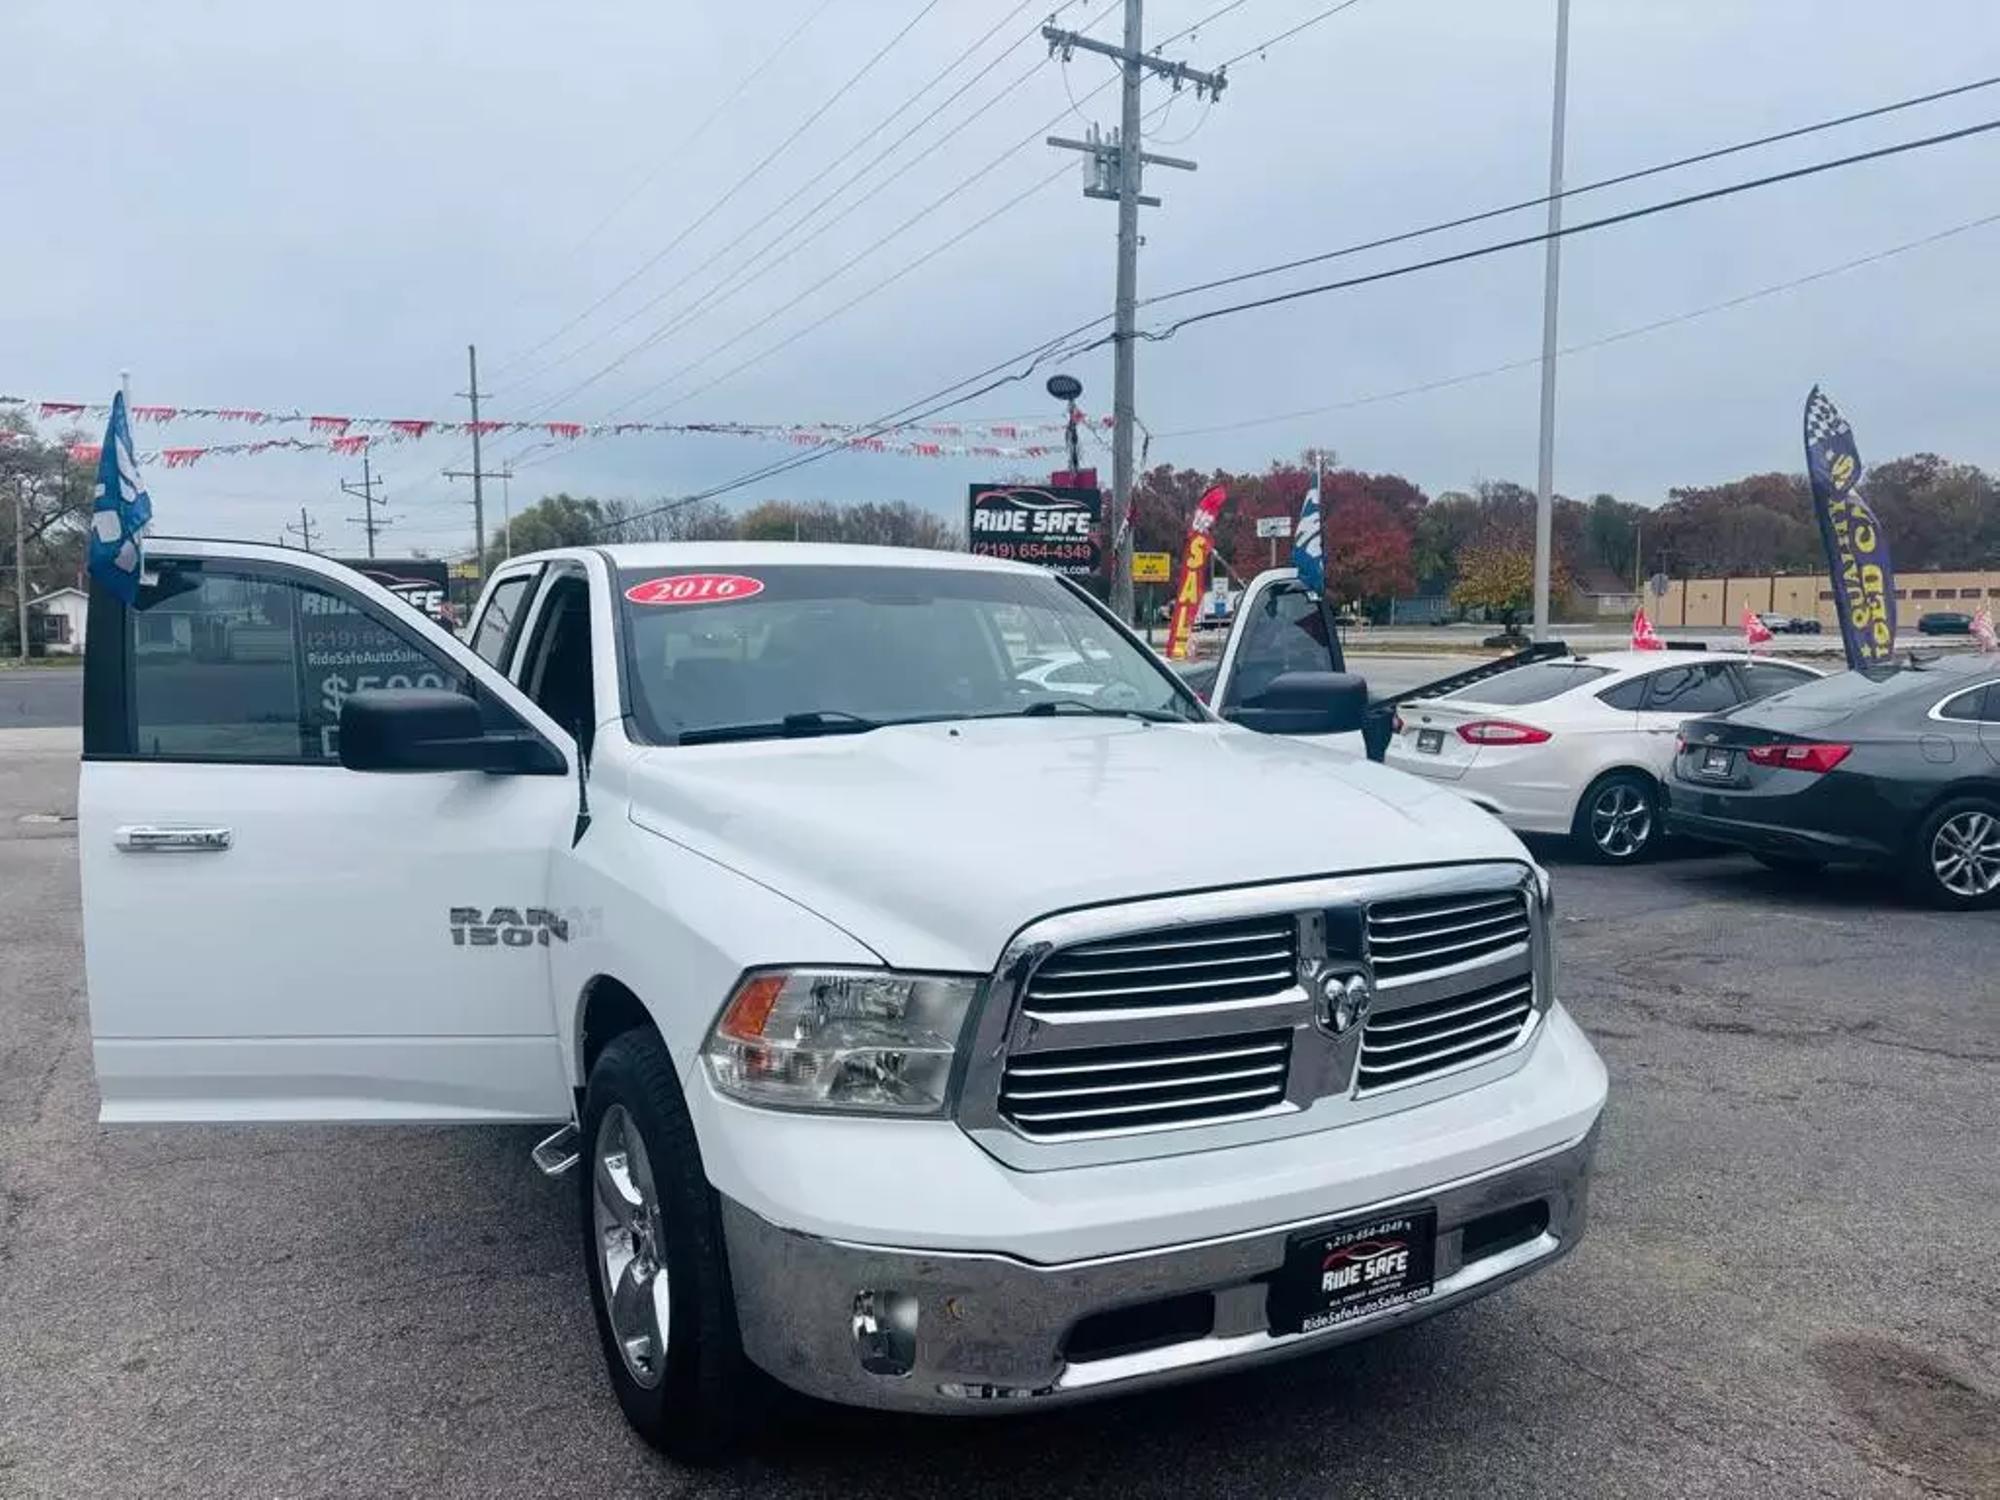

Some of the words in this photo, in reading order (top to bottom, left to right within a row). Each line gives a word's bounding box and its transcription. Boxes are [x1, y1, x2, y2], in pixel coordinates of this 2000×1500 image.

[973, 509, 1029, 532] RIDE
[1032, 511, 1091, 534] SAFE
[973, 541, 1016, 558] (219)
[1019, 543, 1091, 559] 654-4349
[651, 579, 736, 601] 2016
[1322, 1264, 1362, 1292] RIDE
[1364, 1250, 1409, 1282] SAFE
[1303, 1286, 1430, 1331] RideSafeAutoSales.com
